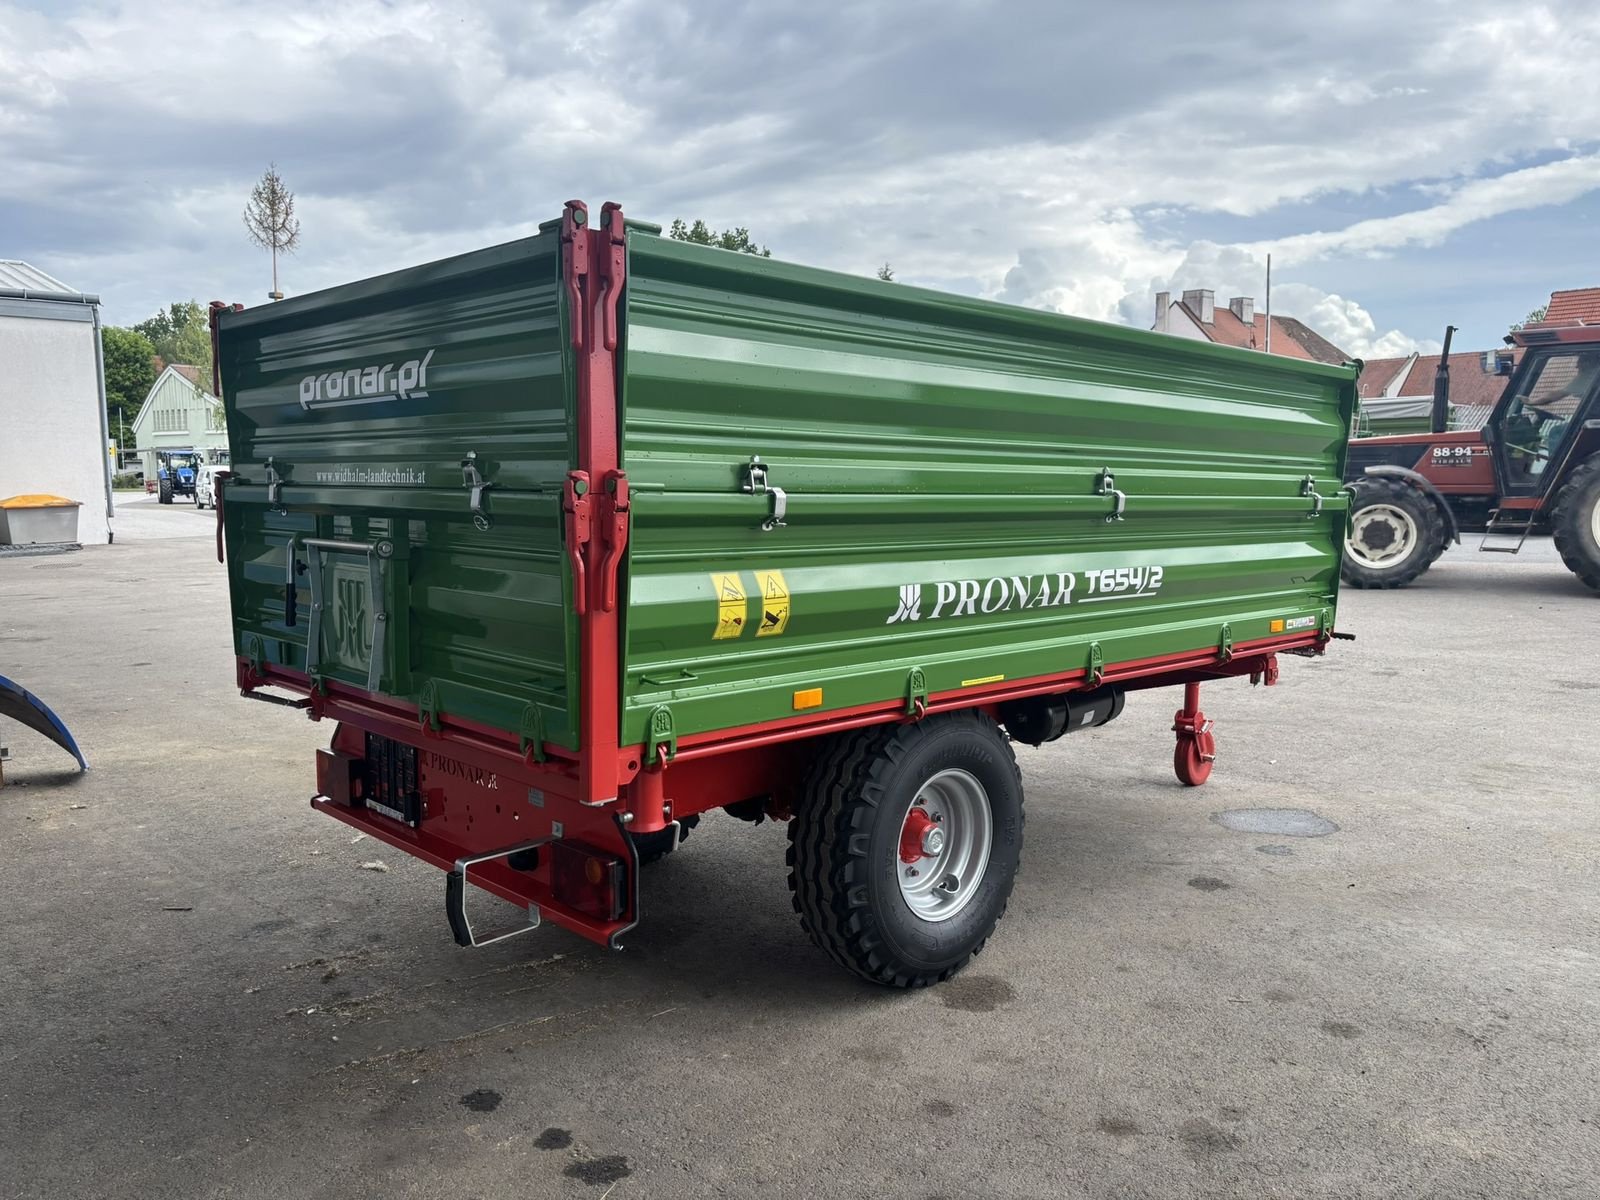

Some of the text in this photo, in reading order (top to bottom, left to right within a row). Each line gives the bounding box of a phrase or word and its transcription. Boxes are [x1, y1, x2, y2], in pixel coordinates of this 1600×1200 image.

[299, 349, 435, 411] pronar.pl
[316, 467, 426, 484] www.widhalm-landtechnik.at
[927, 565, 1164, 619] PRONAR T654/2
[431, 752, 485, 787] PRONAR
